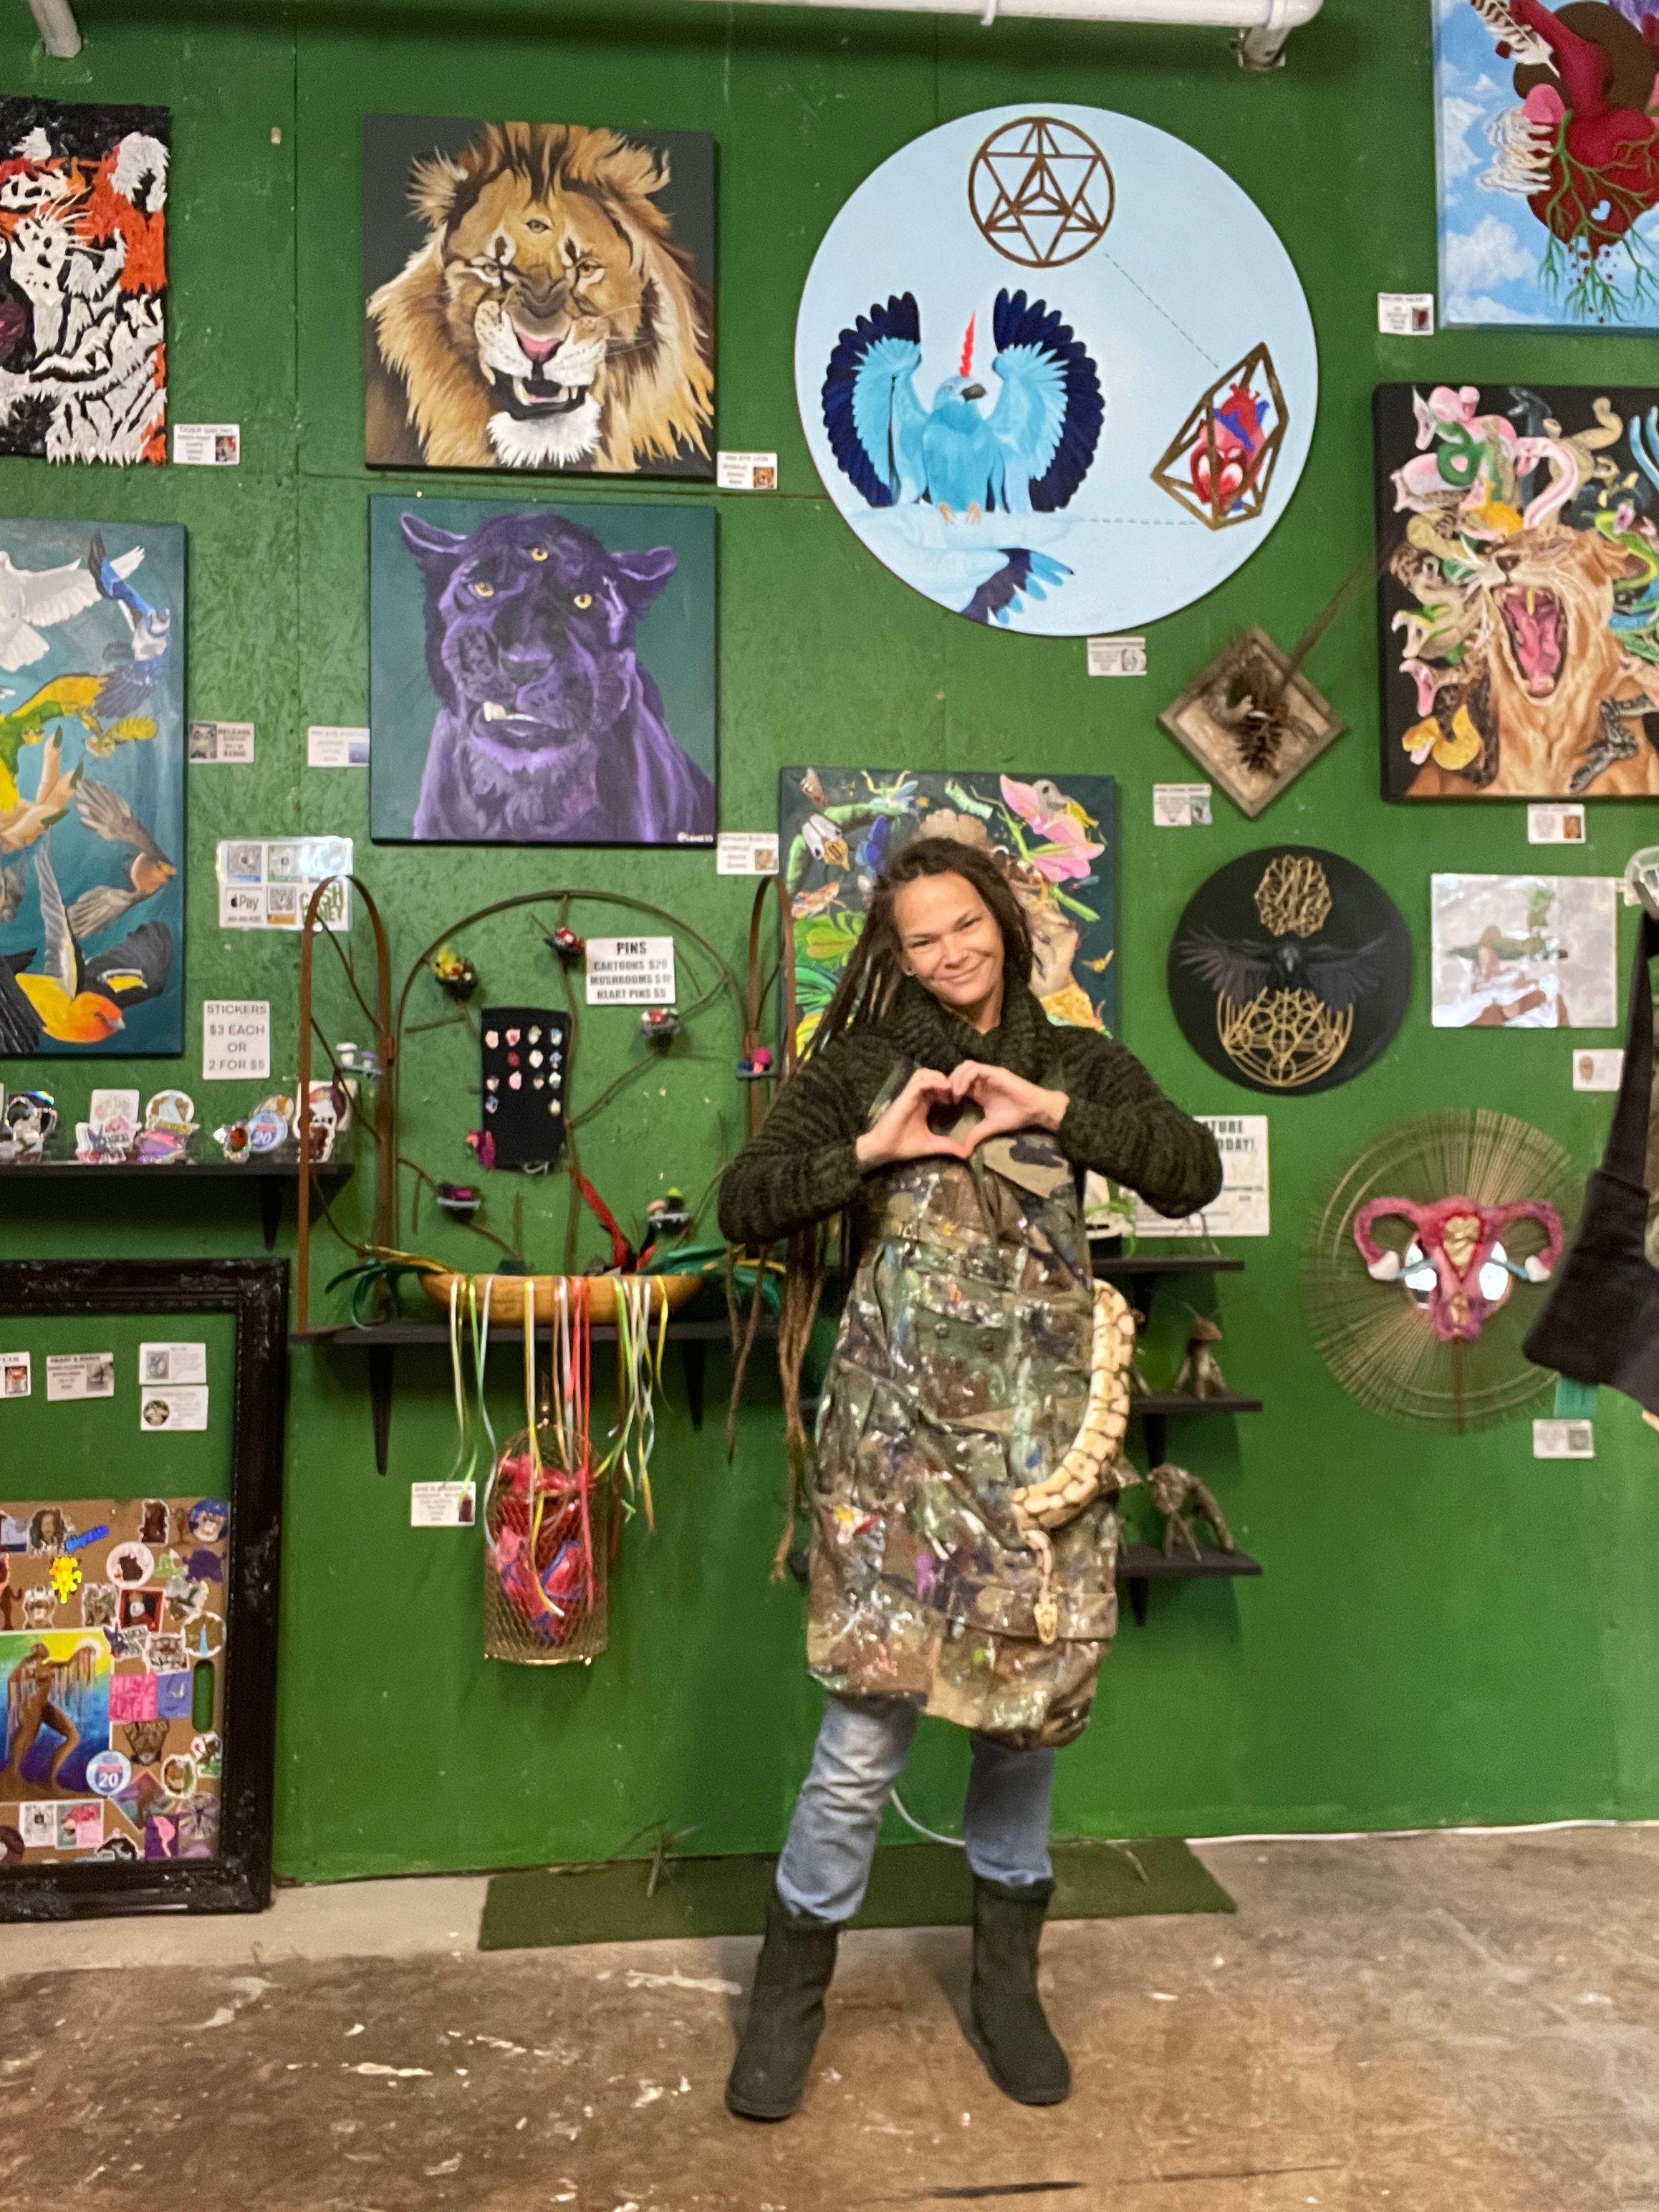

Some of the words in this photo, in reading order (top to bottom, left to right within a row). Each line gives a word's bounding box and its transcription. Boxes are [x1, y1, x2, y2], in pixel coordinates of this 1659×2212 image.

[239, 893, 259, 913] Pay
[617, 941, 647, 956] PINS
[593, 961, 645, 971] CARTOONS
[648, 959, 668, 970] $20
[590, 975, 653, 986] MUSHROOMS
[597, 989, 626, 999] HEART
[629, 989, 651, 999] PINS
[653, 988, 667, 999] $5
[207, 1004, 267, 1014] STICKERS
[209, 1024, 224, 1036] $3
[229, 1024, 265, 1036] EACH
[228, 1042, 247, 1053] OR
[208, 1059, 216, 1070] 2
[220, 1059, 246, 1070] FOR
[251, 1059, 265, 1070] $5
[254, 1131, 272, 1144] 20
[98, 1773, 119, 1788] 20
